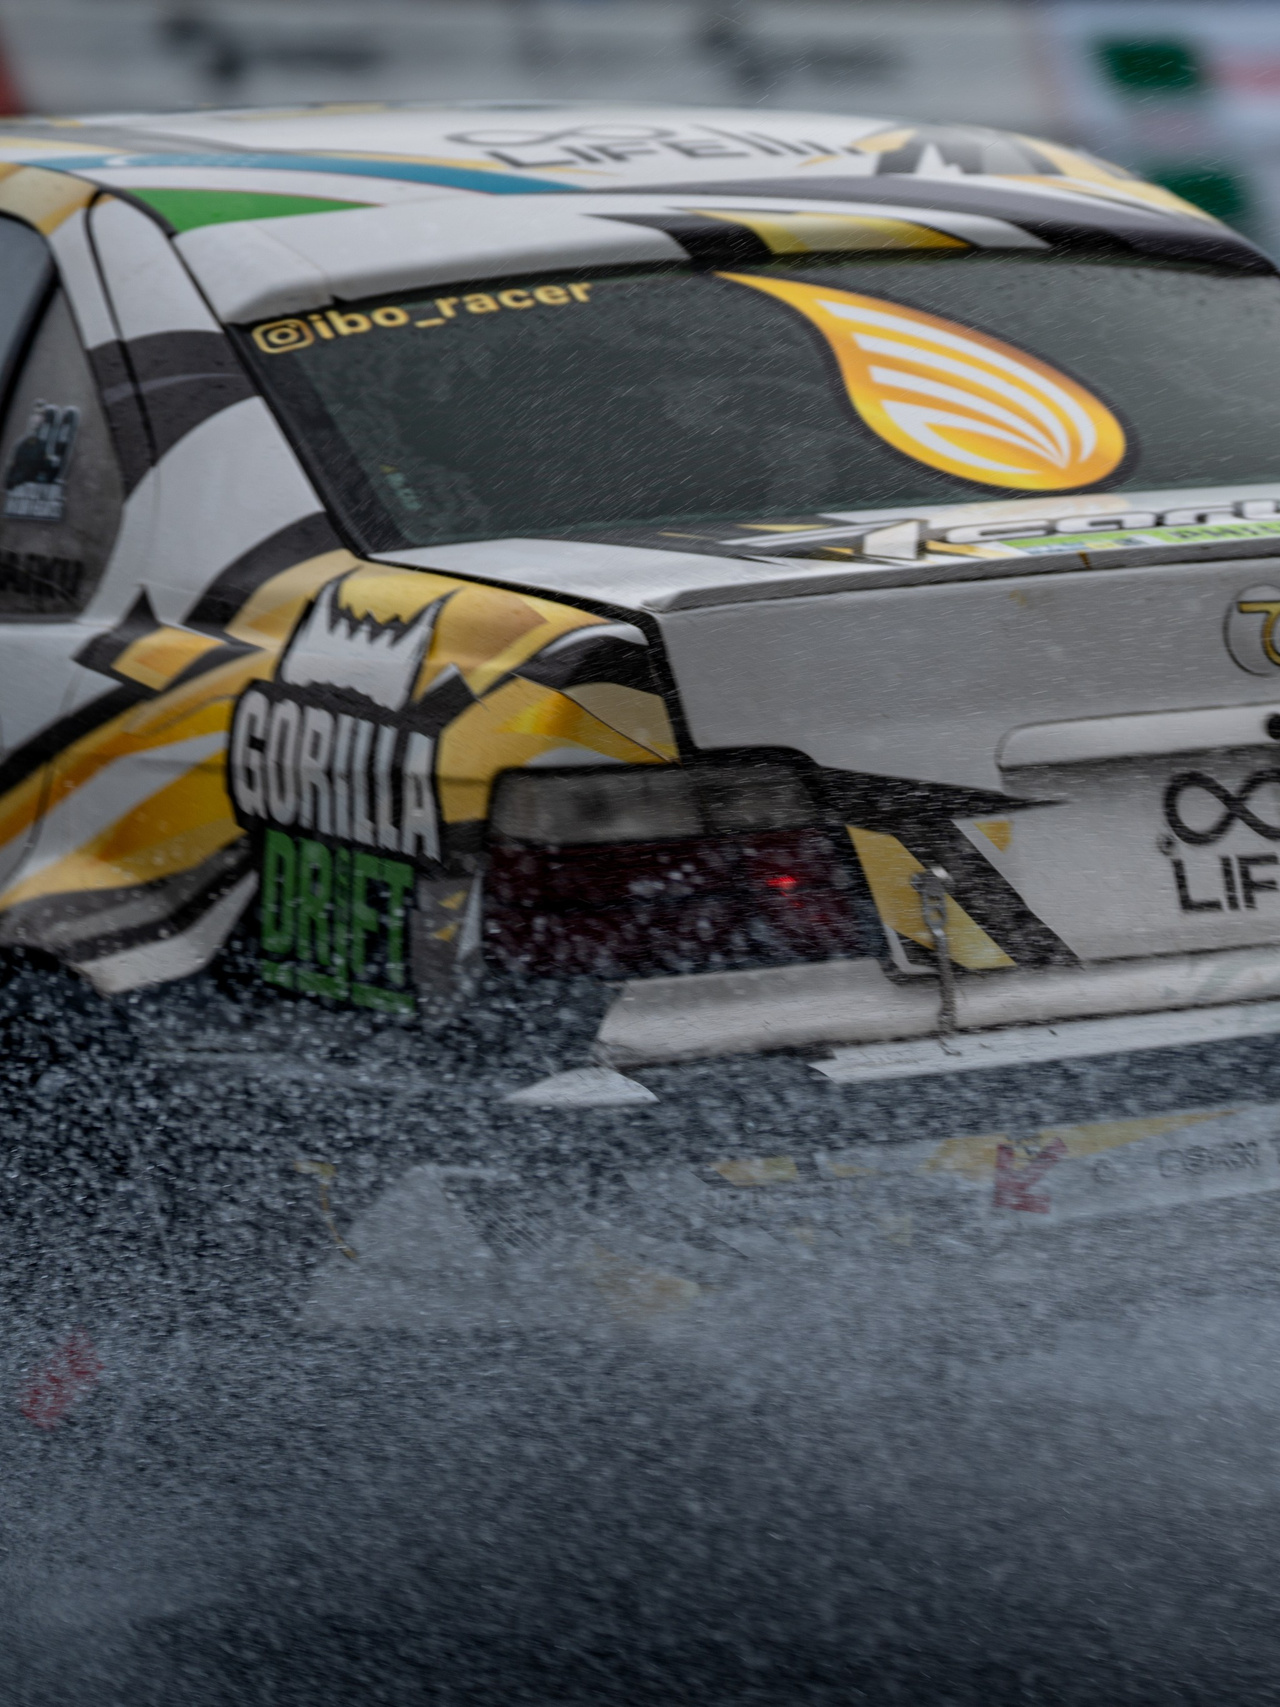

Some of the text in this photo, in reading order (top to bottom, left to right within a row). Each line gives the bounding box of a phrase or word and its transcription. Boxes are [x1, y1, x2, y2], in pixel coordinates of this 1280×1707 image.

[485, 138, 750, 169] LIFE
[231, 690, 442, 864] GORILLA
[261, 828, 415, 988] DRIFT
